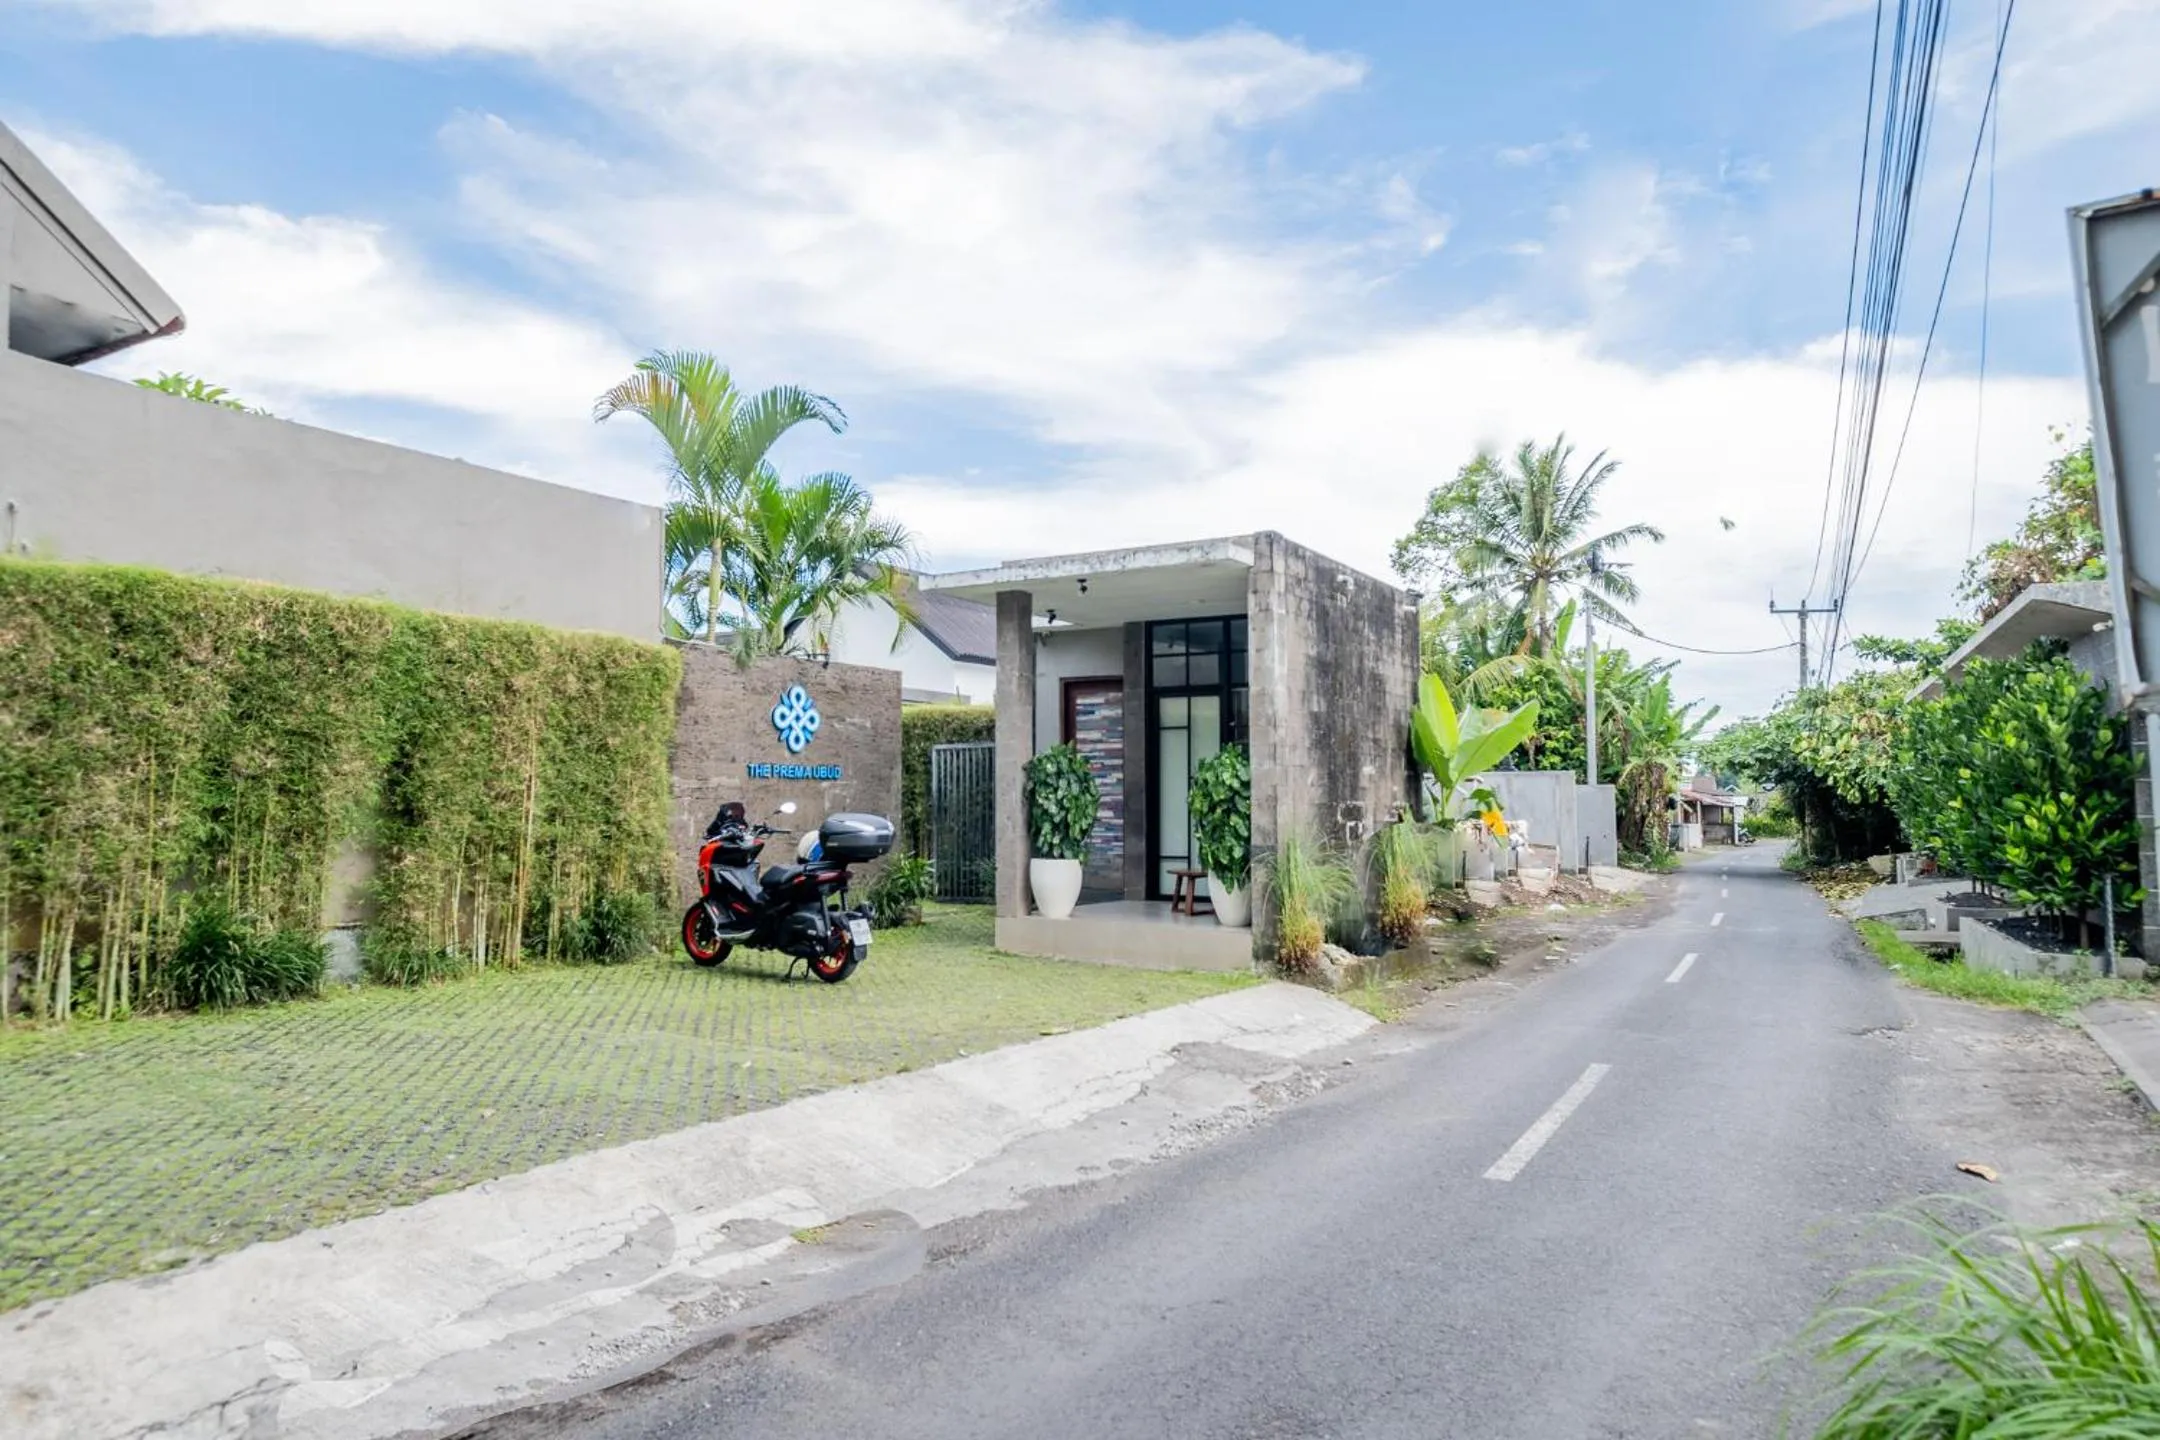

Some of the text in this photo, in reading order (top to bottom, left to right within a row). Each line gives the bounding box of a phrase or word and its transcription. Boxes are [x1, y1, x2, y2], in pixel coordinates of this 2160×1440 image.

[748, 762, 842, 780] THE PREMA UBUD
